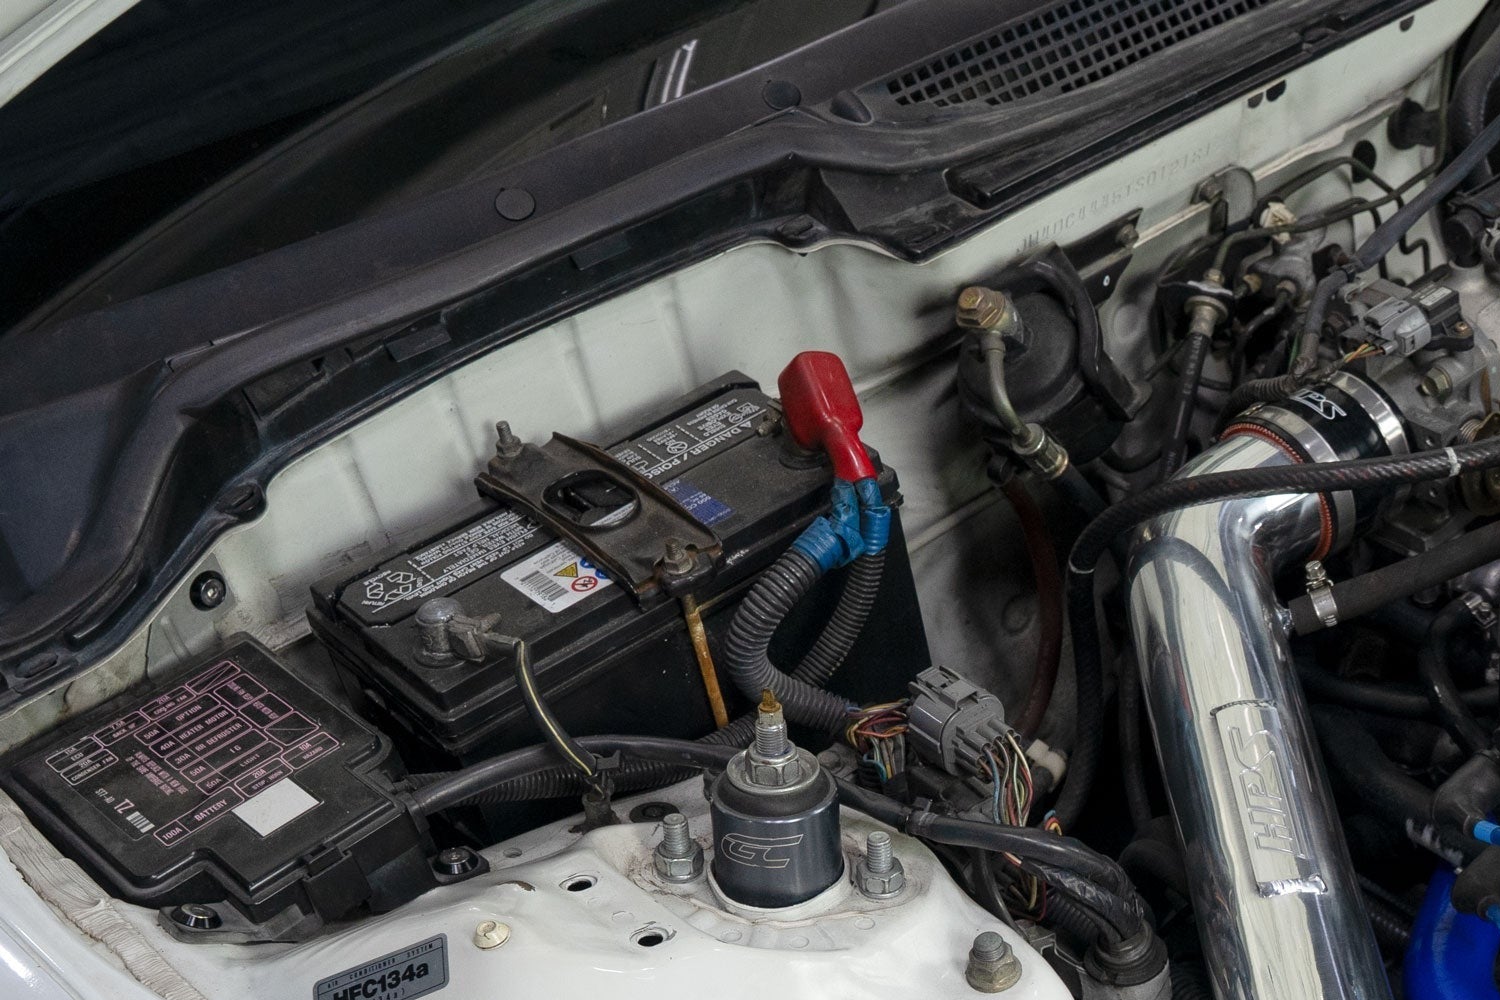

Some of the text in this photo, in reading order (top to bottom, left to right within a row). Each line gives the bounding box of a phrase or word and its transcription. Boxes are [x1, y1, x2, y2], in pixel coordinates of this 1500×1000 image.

[1288, 388, 1347, 421] PS
[689, 427, 741, 455] DANGER
[642, 459, 680, 479] POISO
[453, 522, 518, 556] MEDICAL HELP FAST
[505, 525, 523, 535] WITH
[505, 528, 527, 540] FLUSH
[487, 540, 504, 549] EYES
[442, 549, 486, 572] IMMEDIATELY
[143, 705, 201, 740] 50A OPTION
[160, 709, 229, 751] 40A HEATER MOTOR
[174, 753, 191, 765] 30A
[207, 723, 243, 745] DEFROSTER
[71, 756, 114, 781] CONDENSER FAN
[240, 754, 260, 768] LIGHT
[252, 768, 266, 779] 20A
[1227, 723, 1307, 860] HPS
[162, 799, 227, 841] 100A BATTERY
[327, 943, 433, 989] AIR CONDITIONER SYSTEM
